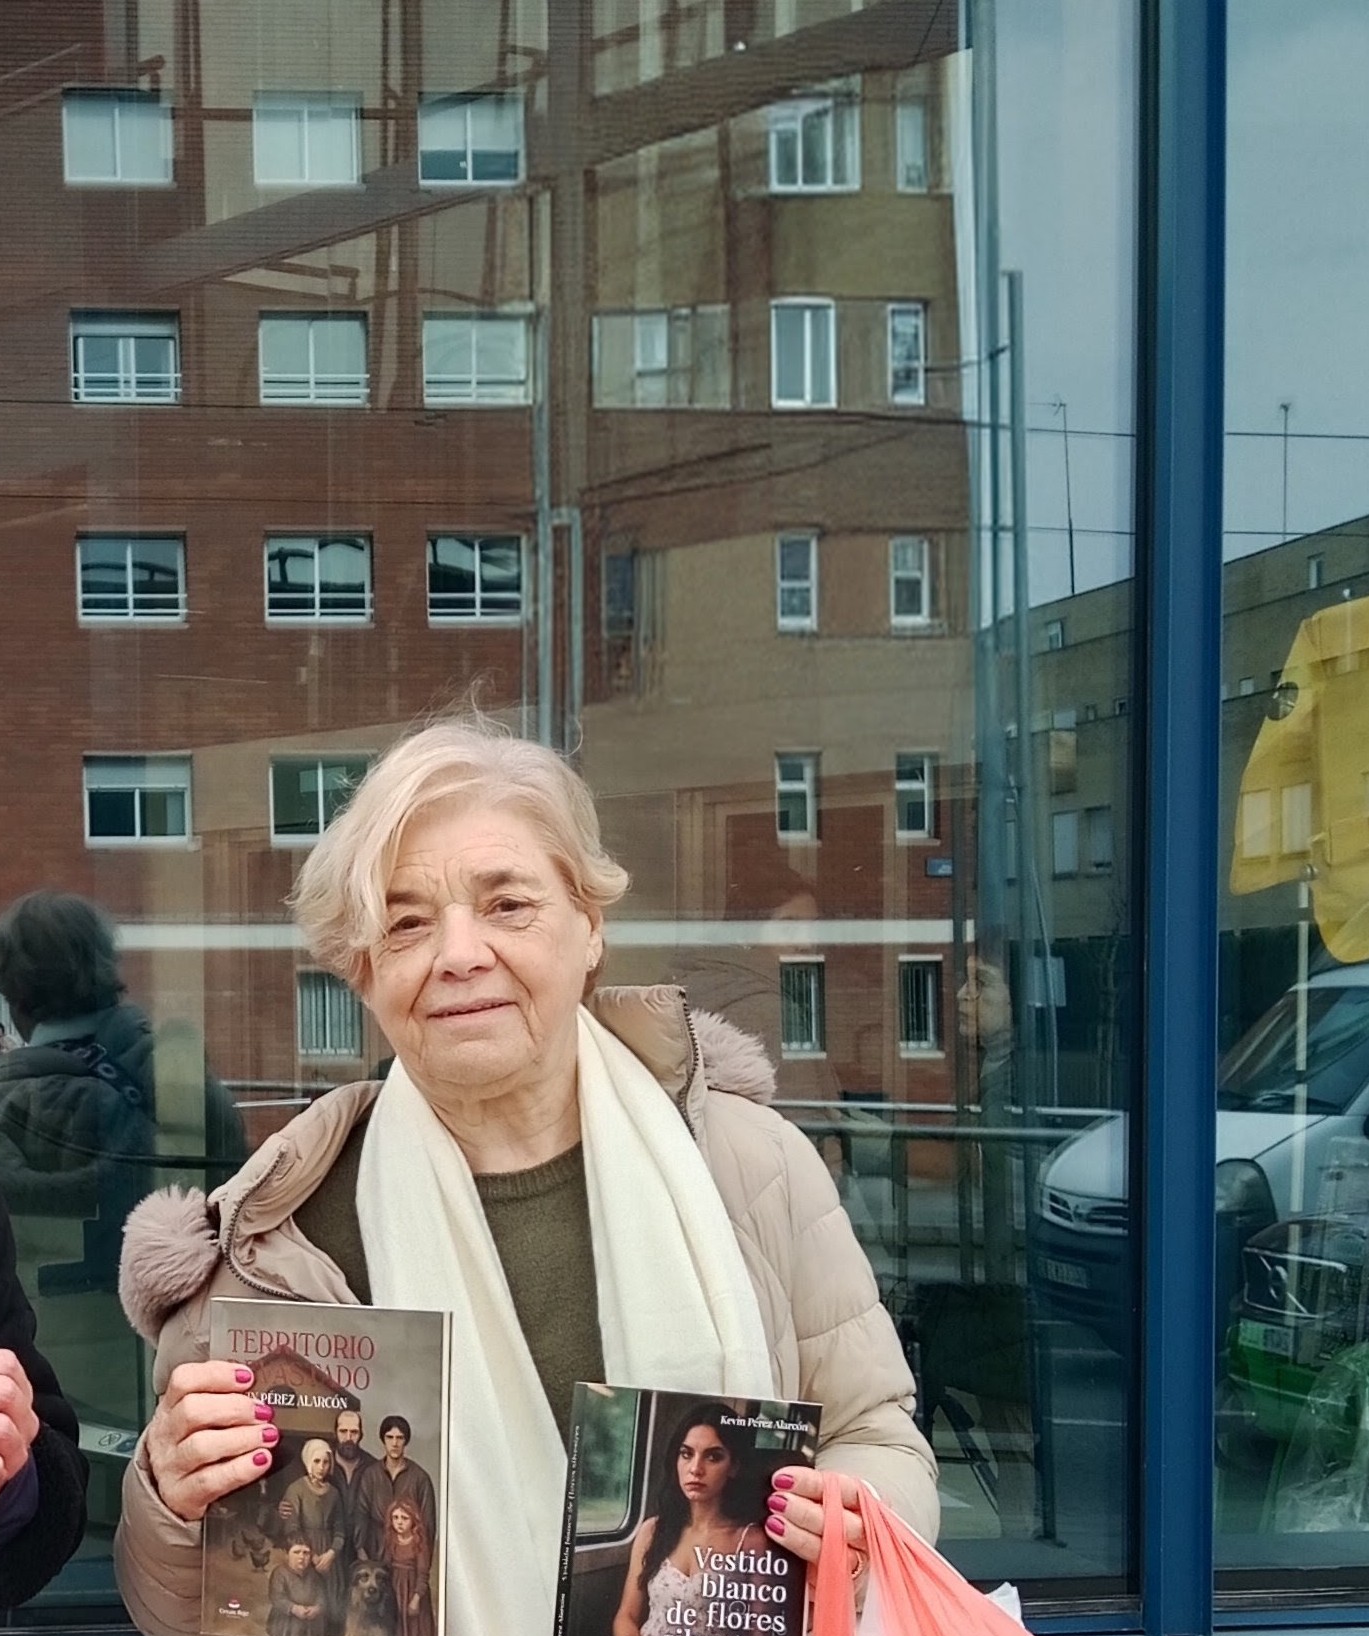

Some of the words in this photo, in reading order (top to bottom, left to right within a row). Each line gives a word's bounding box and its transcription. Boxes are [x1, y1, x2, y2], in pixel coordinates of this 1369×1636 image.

[227, 1329, 375, 1361] TERRITORIO
[260, 1390, 296, 1406] PÉREZ
[297, 1393, 348, 1409] ALARCÓN
[721, 1415, 746, 1426] Kevin
[747, 1416, 773, 1428] Pérez
[774, 1419, 809, 1432] Alarcón
[694, 1546, 789, 1576] Vestido
[702, 1573, 787, 1603] blanco
[666, 1601, 696, 1626] de
[706, 1602, 786, 1632] flores
